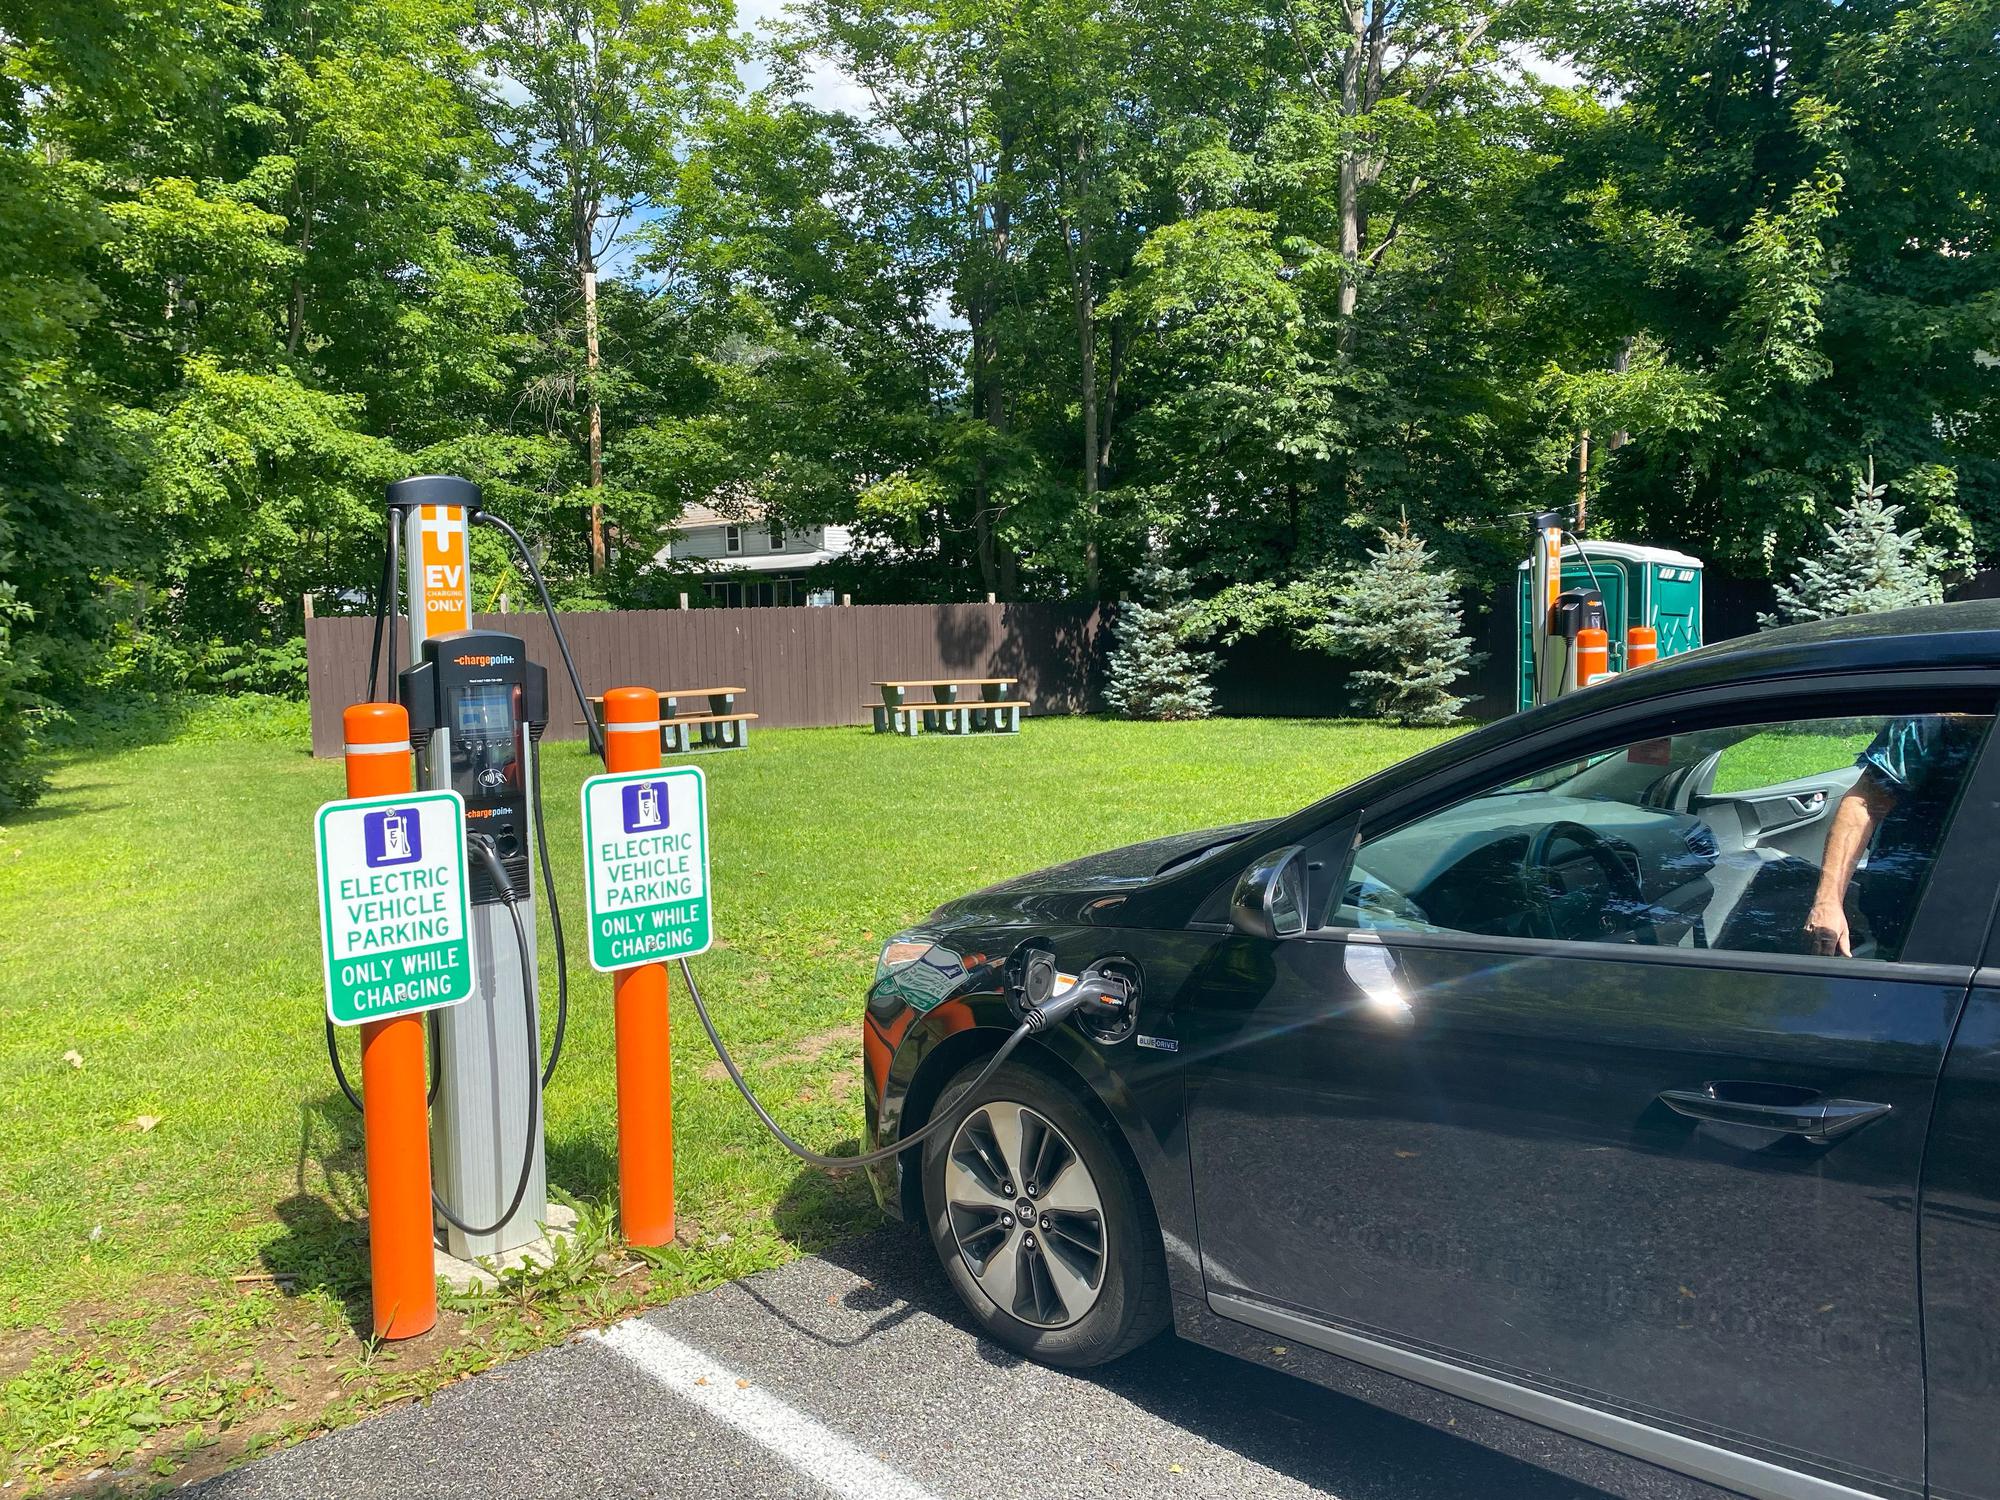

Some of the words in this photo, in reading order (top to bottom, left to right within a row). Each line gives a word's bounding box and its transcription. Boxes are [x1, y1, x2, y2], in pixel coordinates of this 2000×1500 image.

[426, 565, 462, 588] EV
[427, 599, 464, 612] ONLY
[602, 833, 692, 862] ELECTRIC
[340, 866, 449, 900] ELECTRIC
[608, 855, 690, 883] VEHICLE
[347, 891, 447, 925] VEHICLE
[607, 877, 692, 907] PARKING
[347, 917, 449, 952] PARKING
[601, 913, 645, 937] ONLY
[651, 904, 700, 928] WHILE
[611, 928, 693, 959] CHARGING
[342, 958, 394, 987] ONLY
[401, 947, 459, 975] WHILE
[353, 974, 452, 1011] CHARGING
